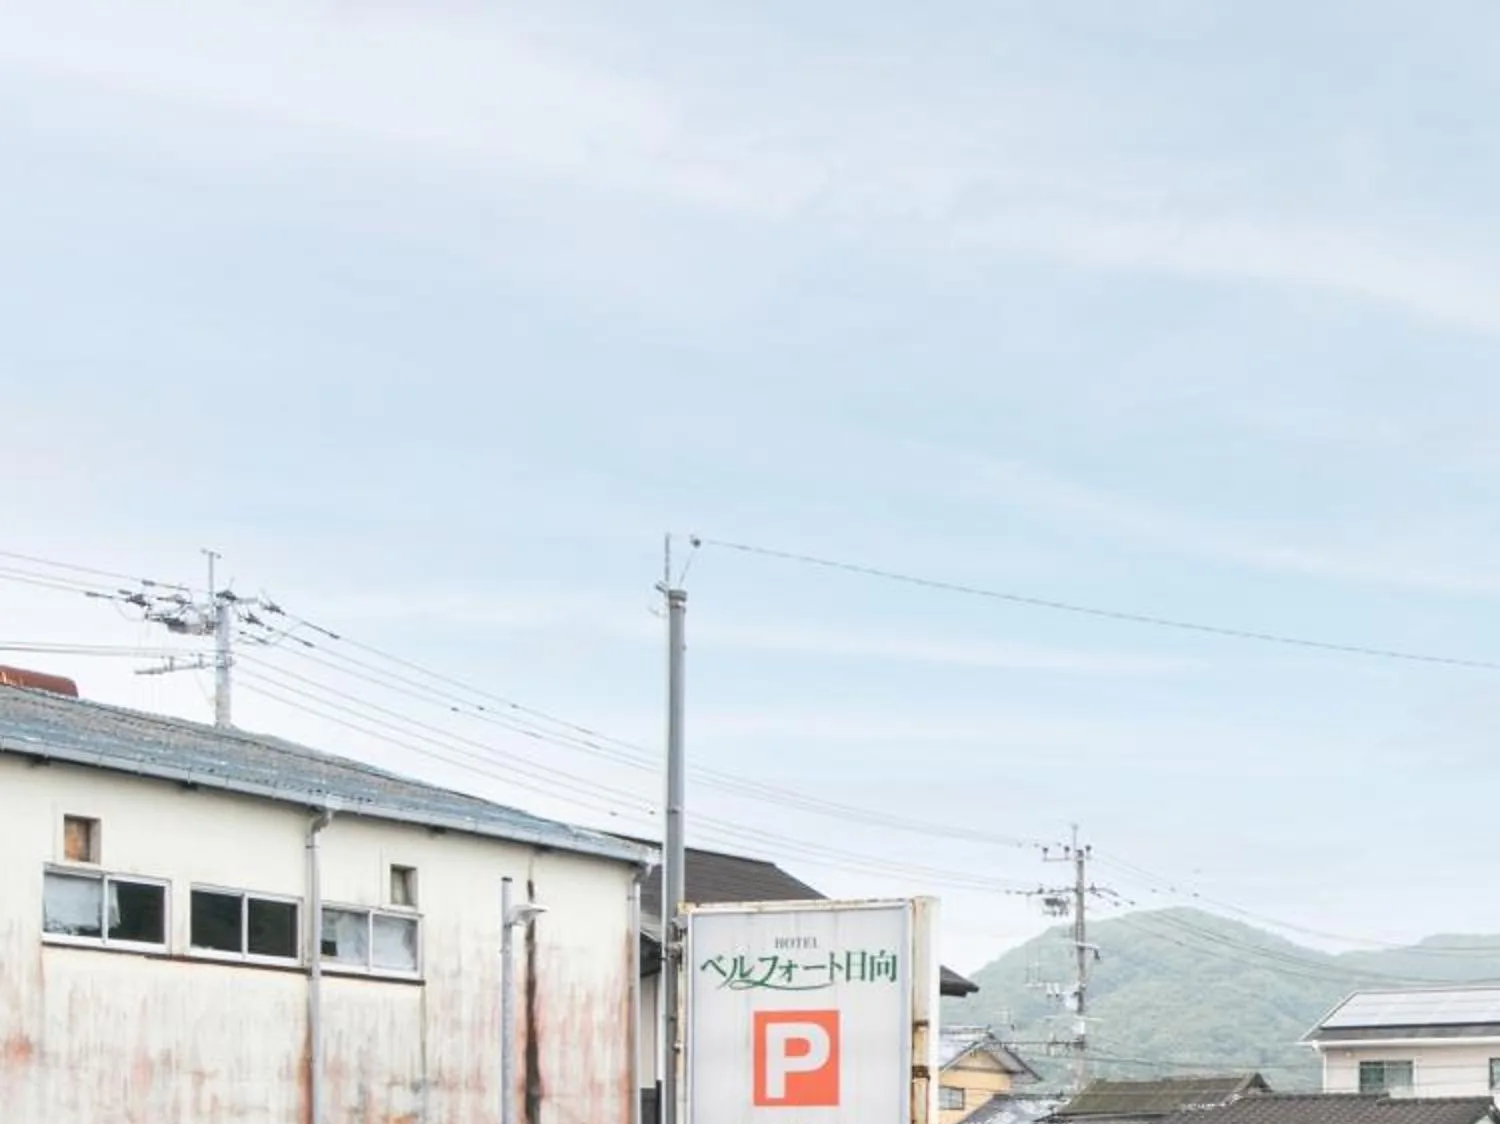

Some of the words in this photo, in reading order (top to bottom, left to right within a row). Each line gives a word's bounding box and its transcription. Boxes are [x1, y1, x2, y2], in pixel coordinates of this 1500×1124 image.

[774, 936, 819, 949] HOTEL
[700, 949, 898, 988] ベルフォート日向
[765, 1022, 831, 1100] P
